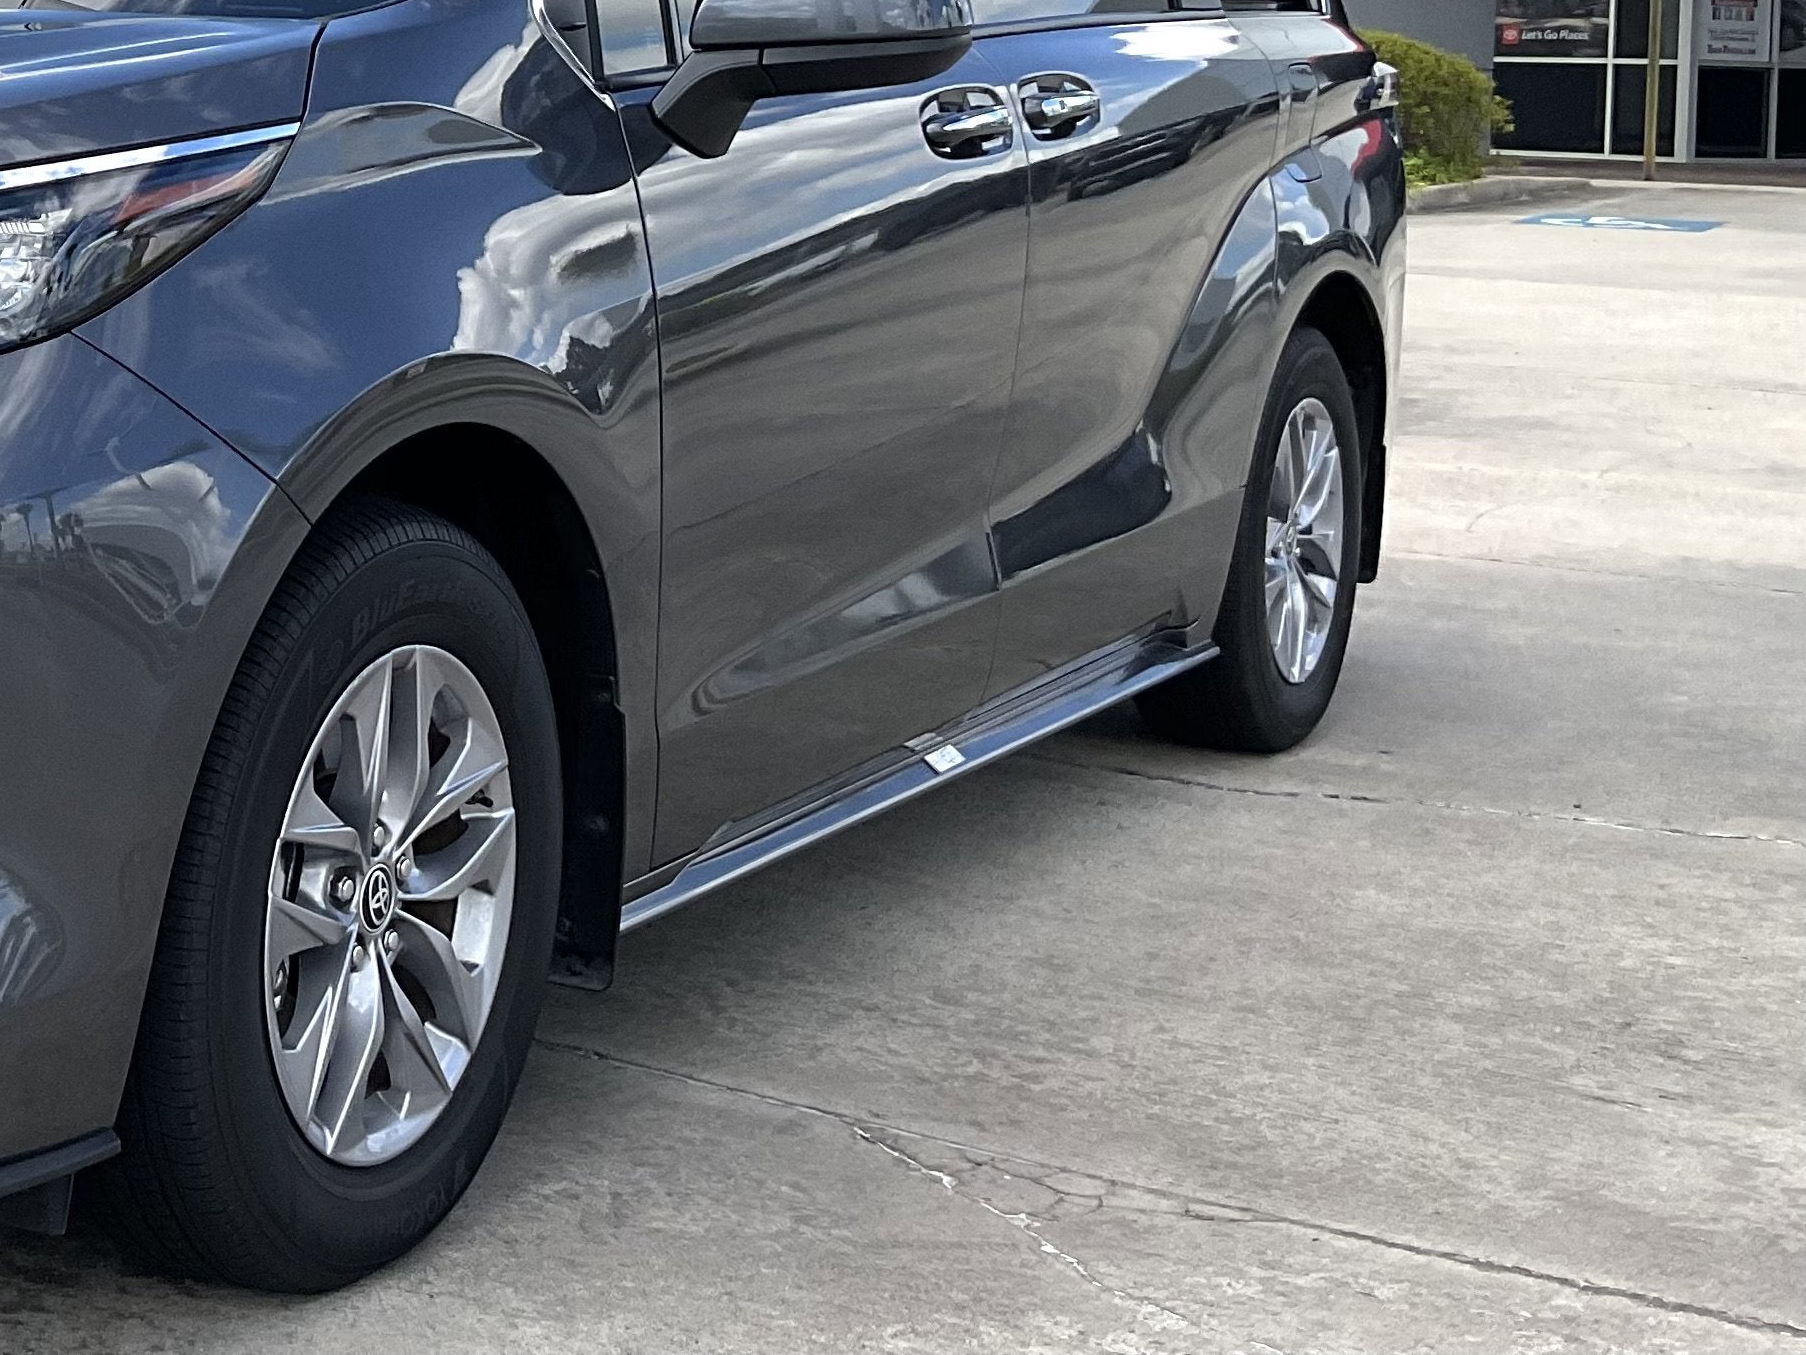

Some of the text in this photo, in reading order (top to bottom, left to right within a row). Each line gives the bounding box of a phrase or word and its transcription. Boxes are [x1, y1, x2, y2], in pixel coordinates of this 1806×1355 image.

[1521, 29, 1589, 40] Let's Go Places
